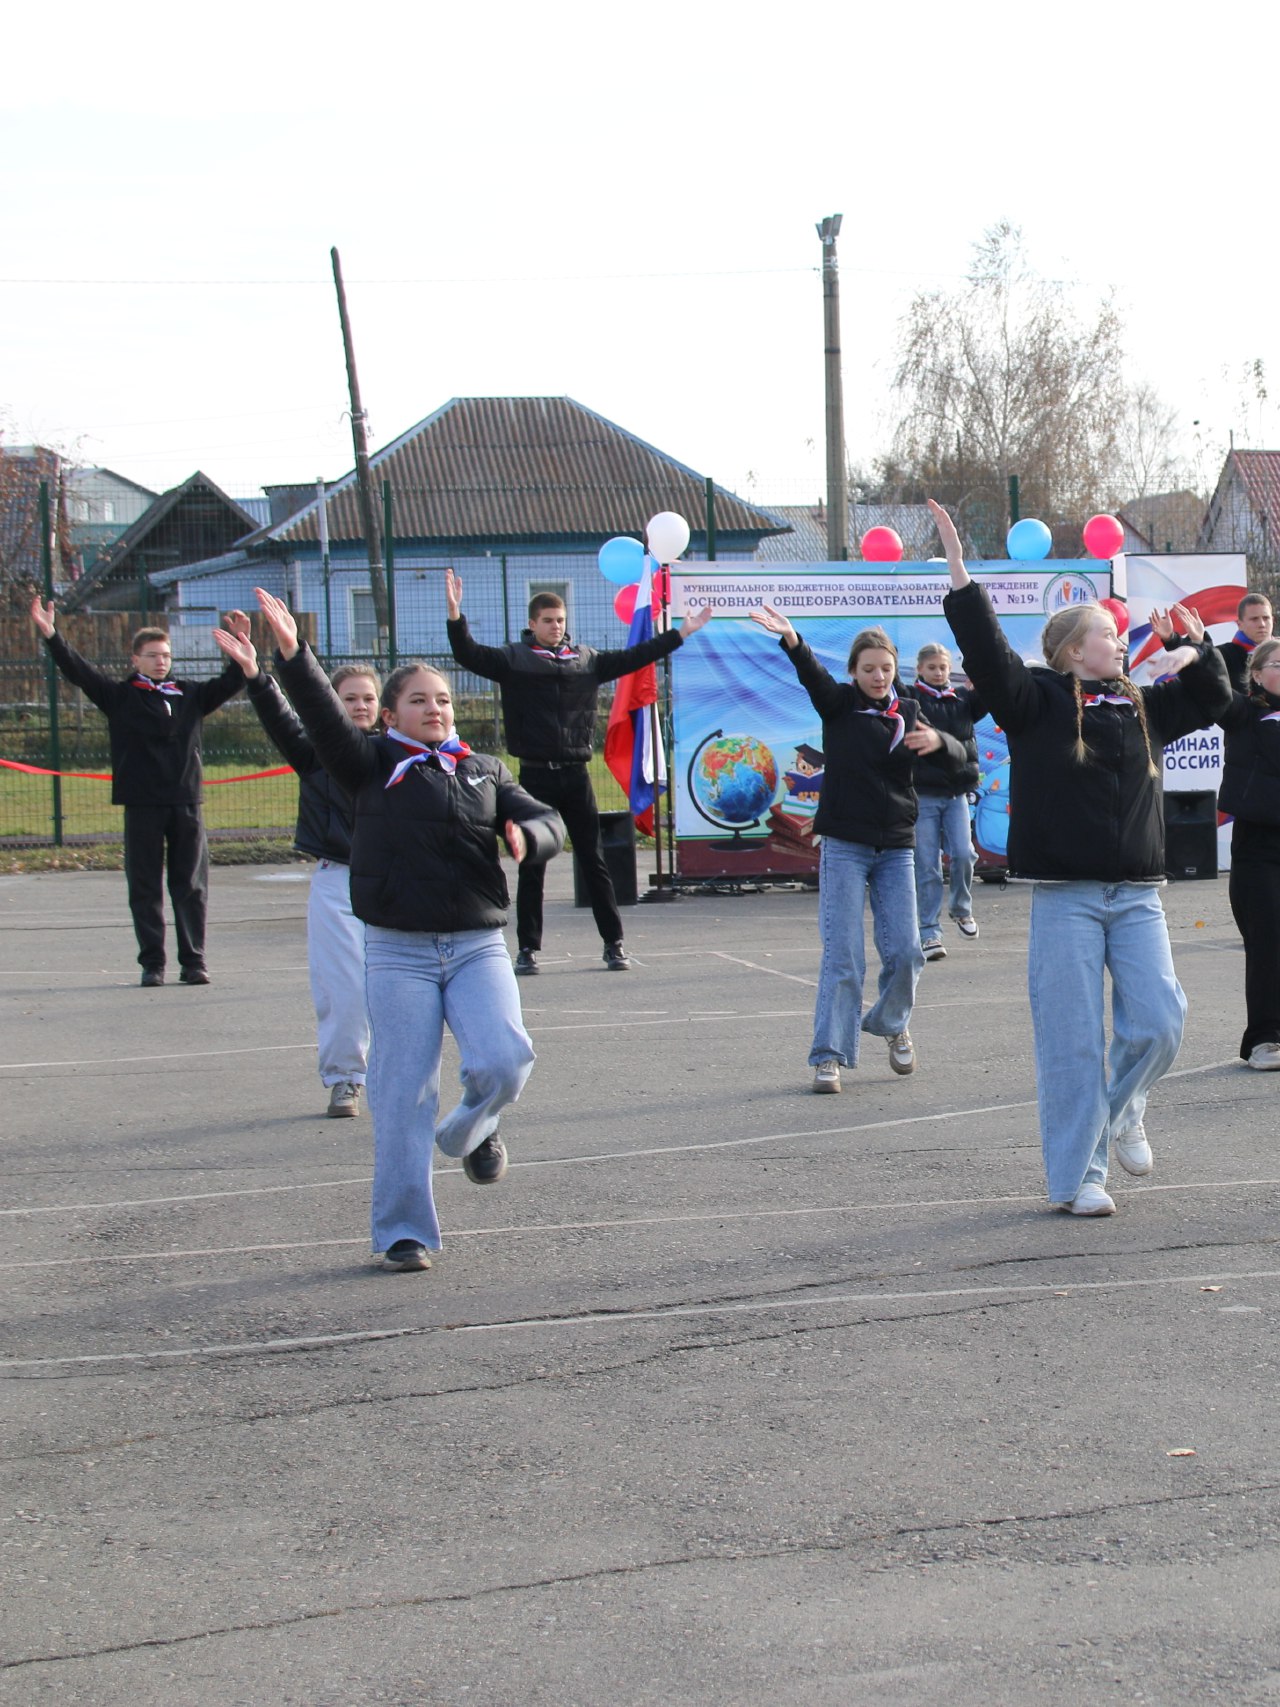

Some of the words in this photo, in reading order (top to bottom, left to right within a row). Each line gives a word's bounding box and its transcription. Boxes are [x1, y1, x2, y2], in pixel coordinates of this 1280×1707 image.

[683, 584, 775, 593] МУНИЦИПАЛЬНОЕ
[778, 583, 845, 593] БЮДЖЕТНОЕ
[847, 583, 951, 592] ОБЩЕОБРАЗОВАТЕЛЬ
[983, 582, 1039, 591] РЕЖДЕНИЕ
[773, 595, 942, 607] ОБЩЕОБРАЗОВАТЕЛЬНАЯ
[1163, 736, 1220, 755] ДИНАЯ
[1165, 754, 1220, 770] ОССИЯ
